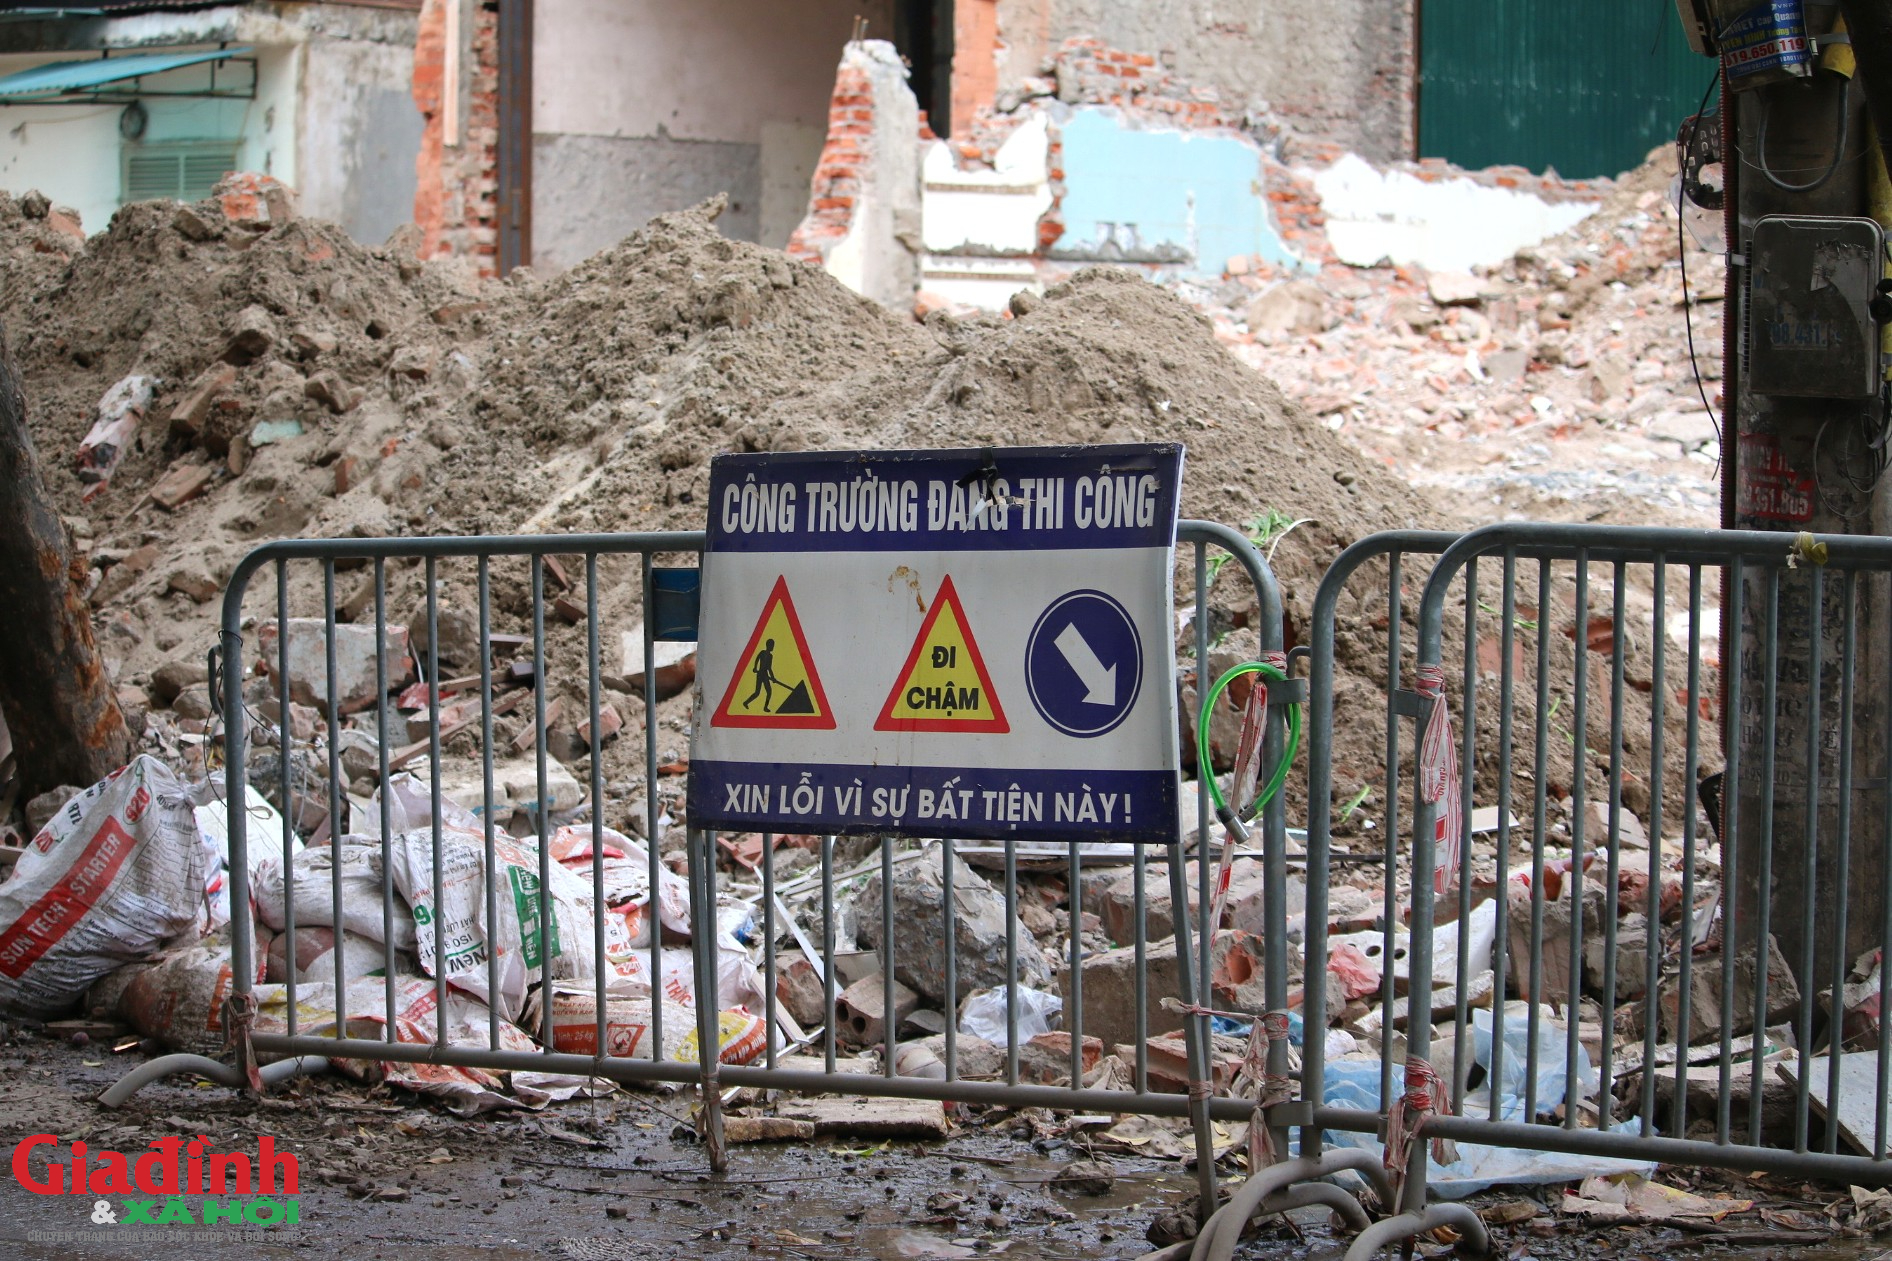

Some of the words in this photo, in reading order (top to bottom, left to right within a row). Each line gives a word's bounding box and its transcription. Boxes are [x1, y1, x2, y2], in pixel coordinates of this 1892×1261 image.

[721, 472, 797, 534] CÔNG
[805, 468, 919, 533] TRƯỜNG
[1019, 476, 1065, 530] THI
[1074, 463, 1159, 530] CÔNG
[931, 645, 957, 669] ĐI
[906, 680, 979, 717] CHẬM
[126, 786, 151, 822] 920
[723, 783, 770, 814] XIN
[779, 771, 825, 815] LỖI
[834, 777, 863, 816] VÌ
[871, 783, 911, 827] SỰ
[917, 775, 974, 820] BẤT
[982, 782, 1043, 831] TIỆN
[1, 932, 36, 966] SUN
[27, 899, 70, 938] TECH
[69, 831, 122, 896] STARTER
[452, 934, 473, 948] ISO
